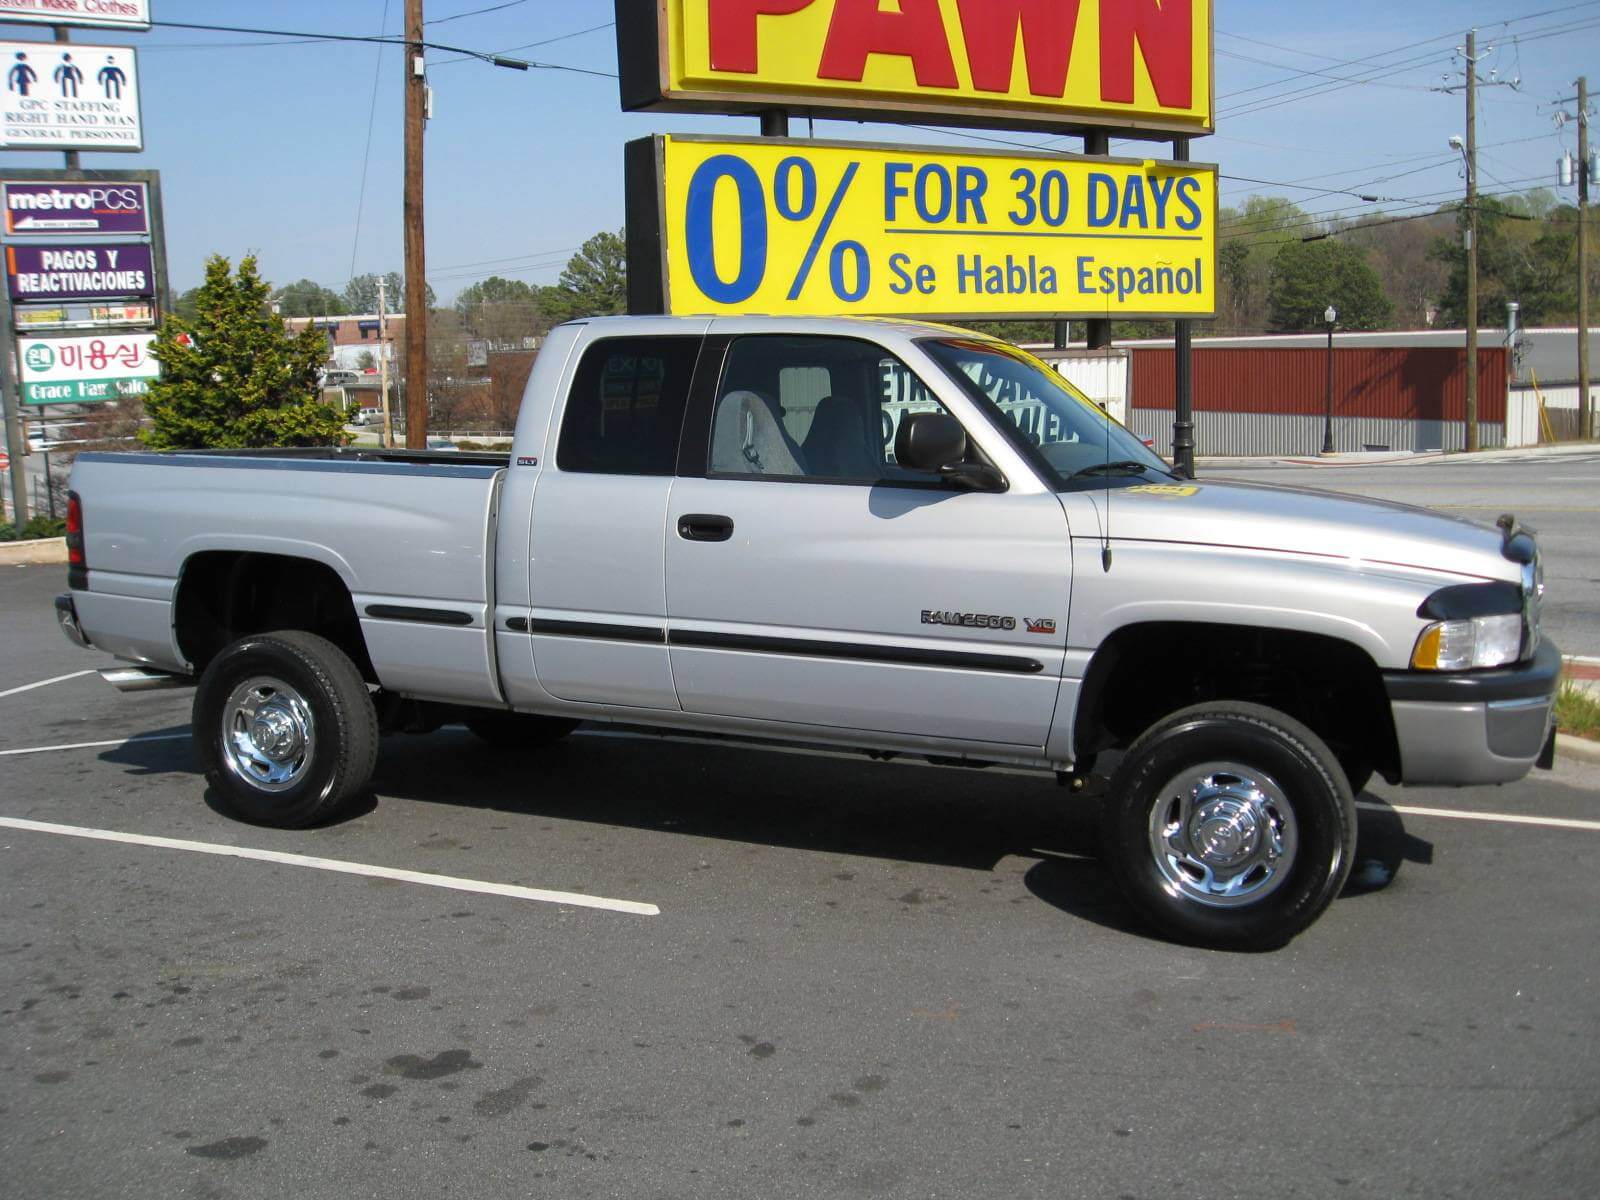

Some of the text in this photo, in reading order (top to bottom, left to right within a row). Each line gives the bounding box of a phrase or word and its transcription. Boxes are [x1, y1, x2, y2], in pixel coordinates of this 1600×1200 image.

[54, 101, 120, 113] STAFFING
[5, 111, 136, 126] RIGHT HAND MAN
[6, 128, 136, 140] GENERAL PERSONNEL
[685, 153, 1203, 304] 0% FOR 30 DAYS
[41, 250, 118, 270] PAGOS Y
[16, 270, 146, 293] REACTIVACIONES
[889, 252, 1203, 303] Se Habla Español
[30, 383, 72, 399] Grace
[921, 610, 961, 626] RAM
[962, 613, 1016, 630] 2500
